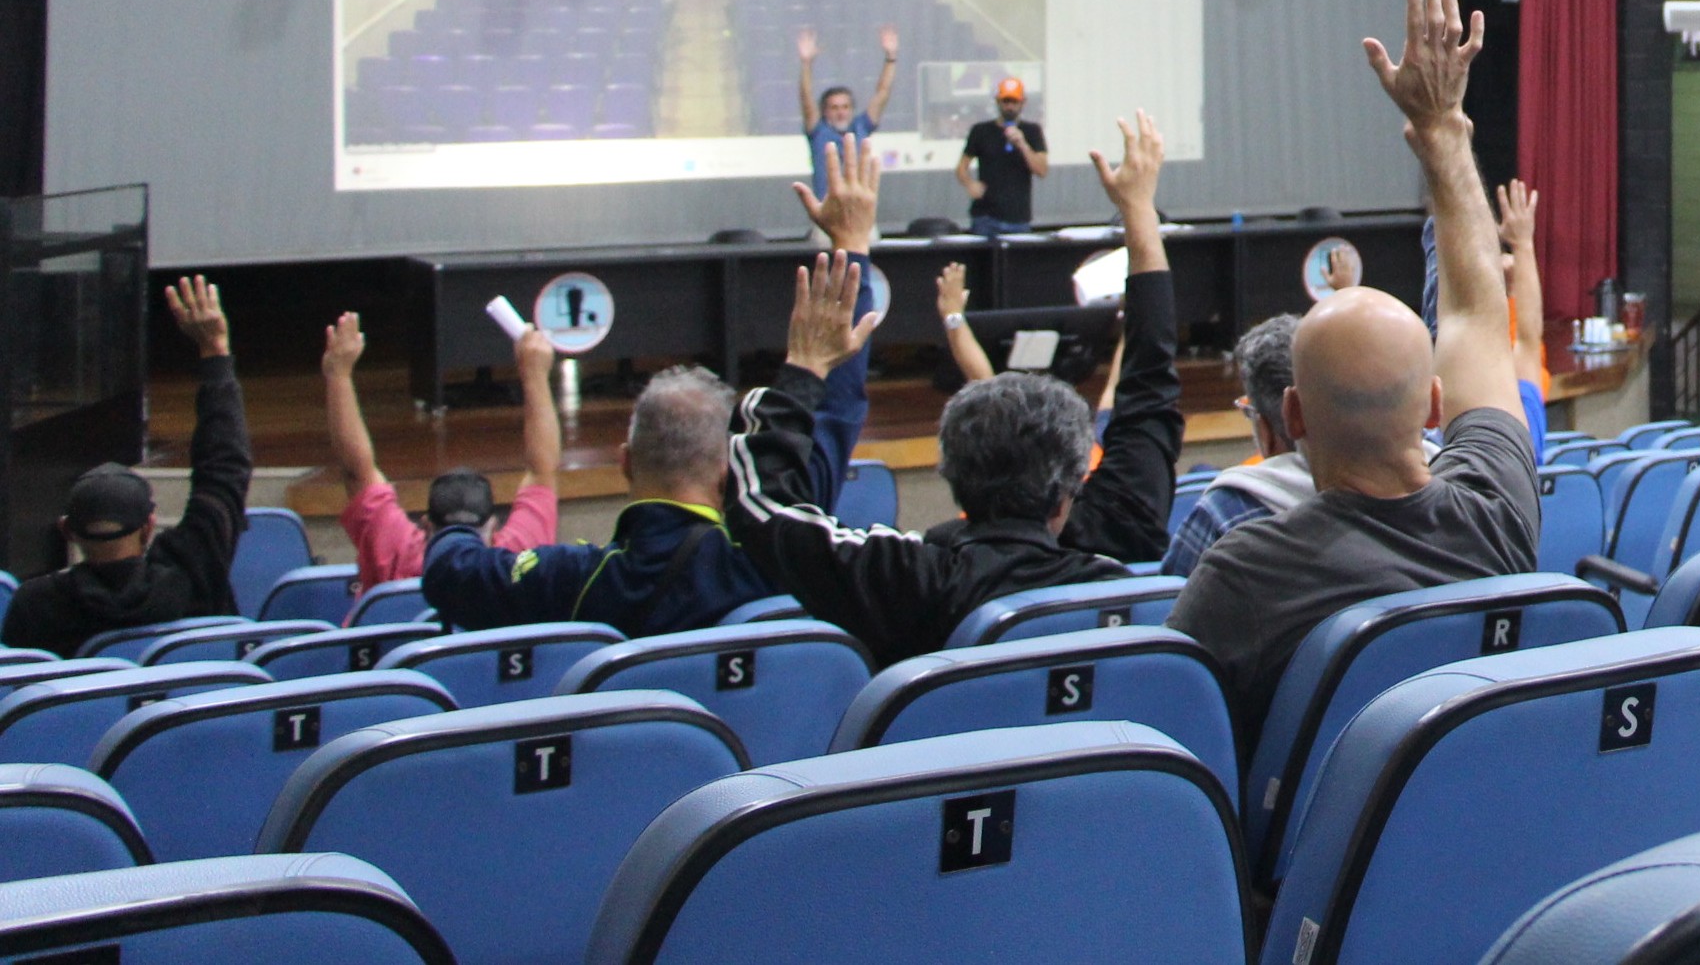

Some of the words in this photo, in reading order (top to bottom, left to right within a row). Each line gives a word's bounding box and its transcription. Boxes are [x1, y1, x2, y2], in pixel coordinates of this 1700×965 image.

[1543, 480, 1551, 493] P
[1493, 618, 1511, 646] R
[358, 648, 370, 667] S
[509, 653, 523, 675] S
[728, 657, 744, 683] S
[1062, 674, 1080, 706] S
[289, 714, 306, 741] T
[1617, 696, 1640, 738] S
[535, 746, 556, 781] T
[967, 807, 991, 855] T
